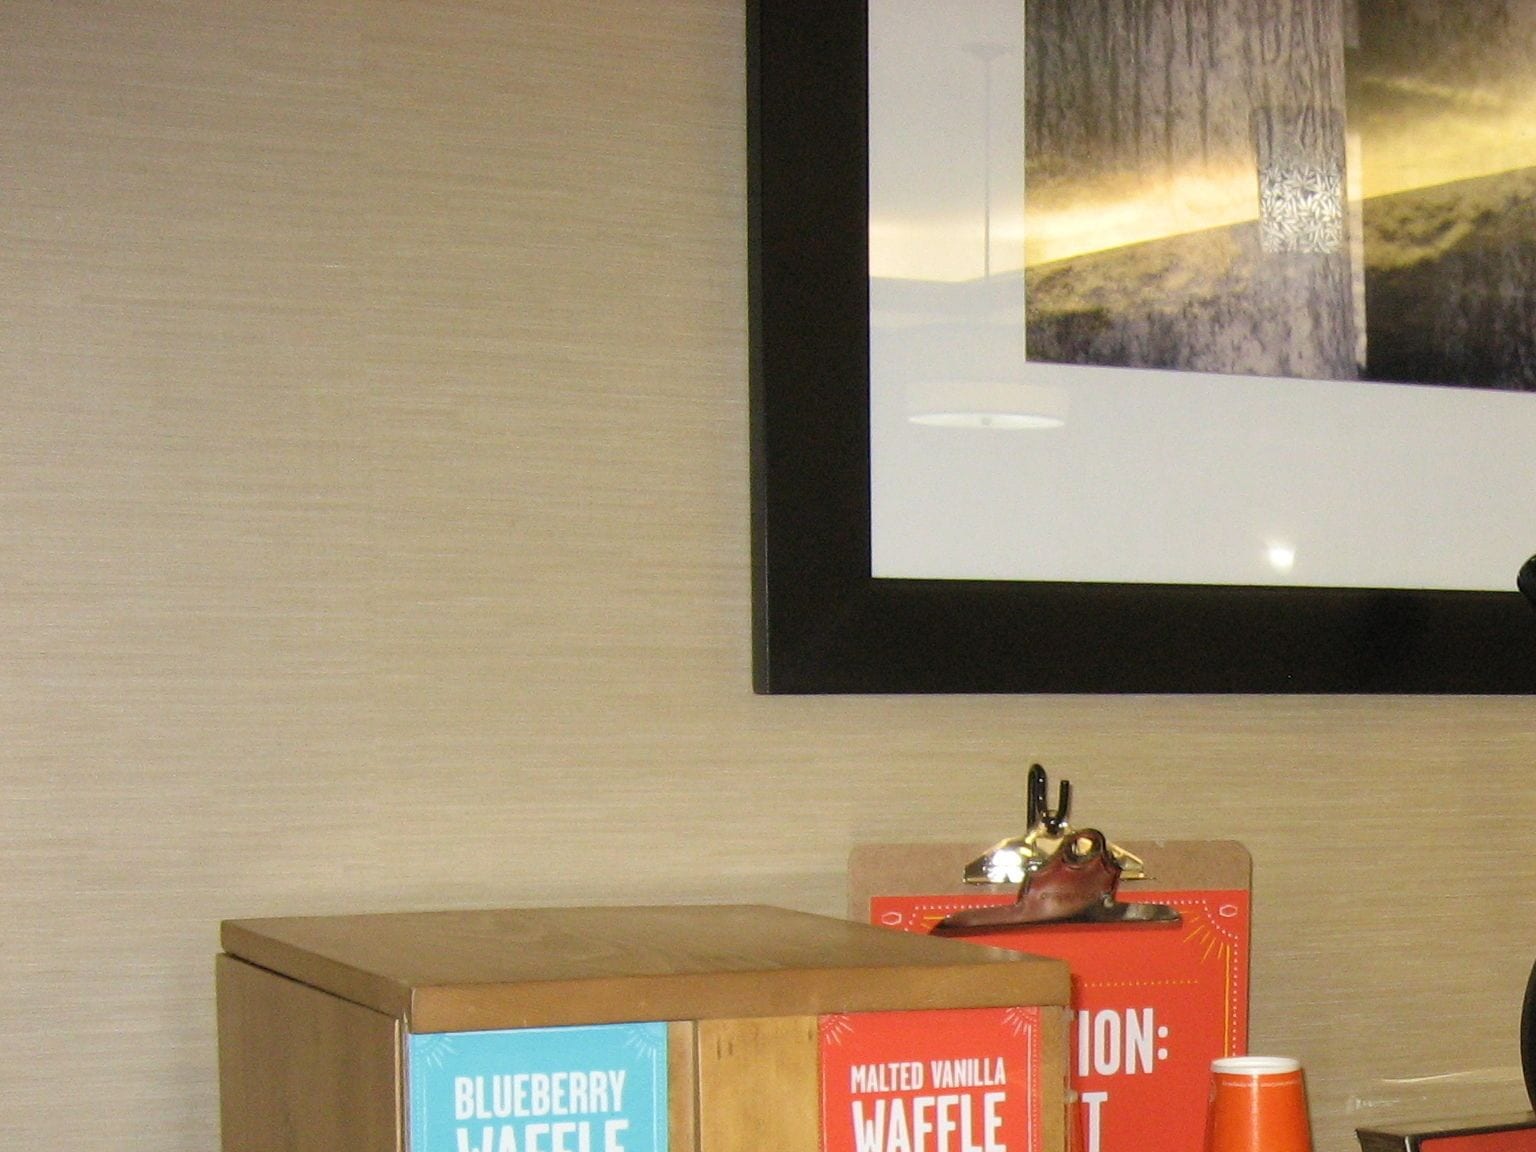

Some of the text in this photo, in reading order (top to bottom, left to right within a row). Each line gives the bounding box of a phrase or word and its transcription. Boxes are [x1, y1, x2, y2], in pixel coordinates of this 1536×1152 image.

[1078, 1007, 1169, 1077] ION:
[455, 1070, 625, 1120] BLUEBERRY
[851, 1056, 1006, 1094] MALTED VANILLA
